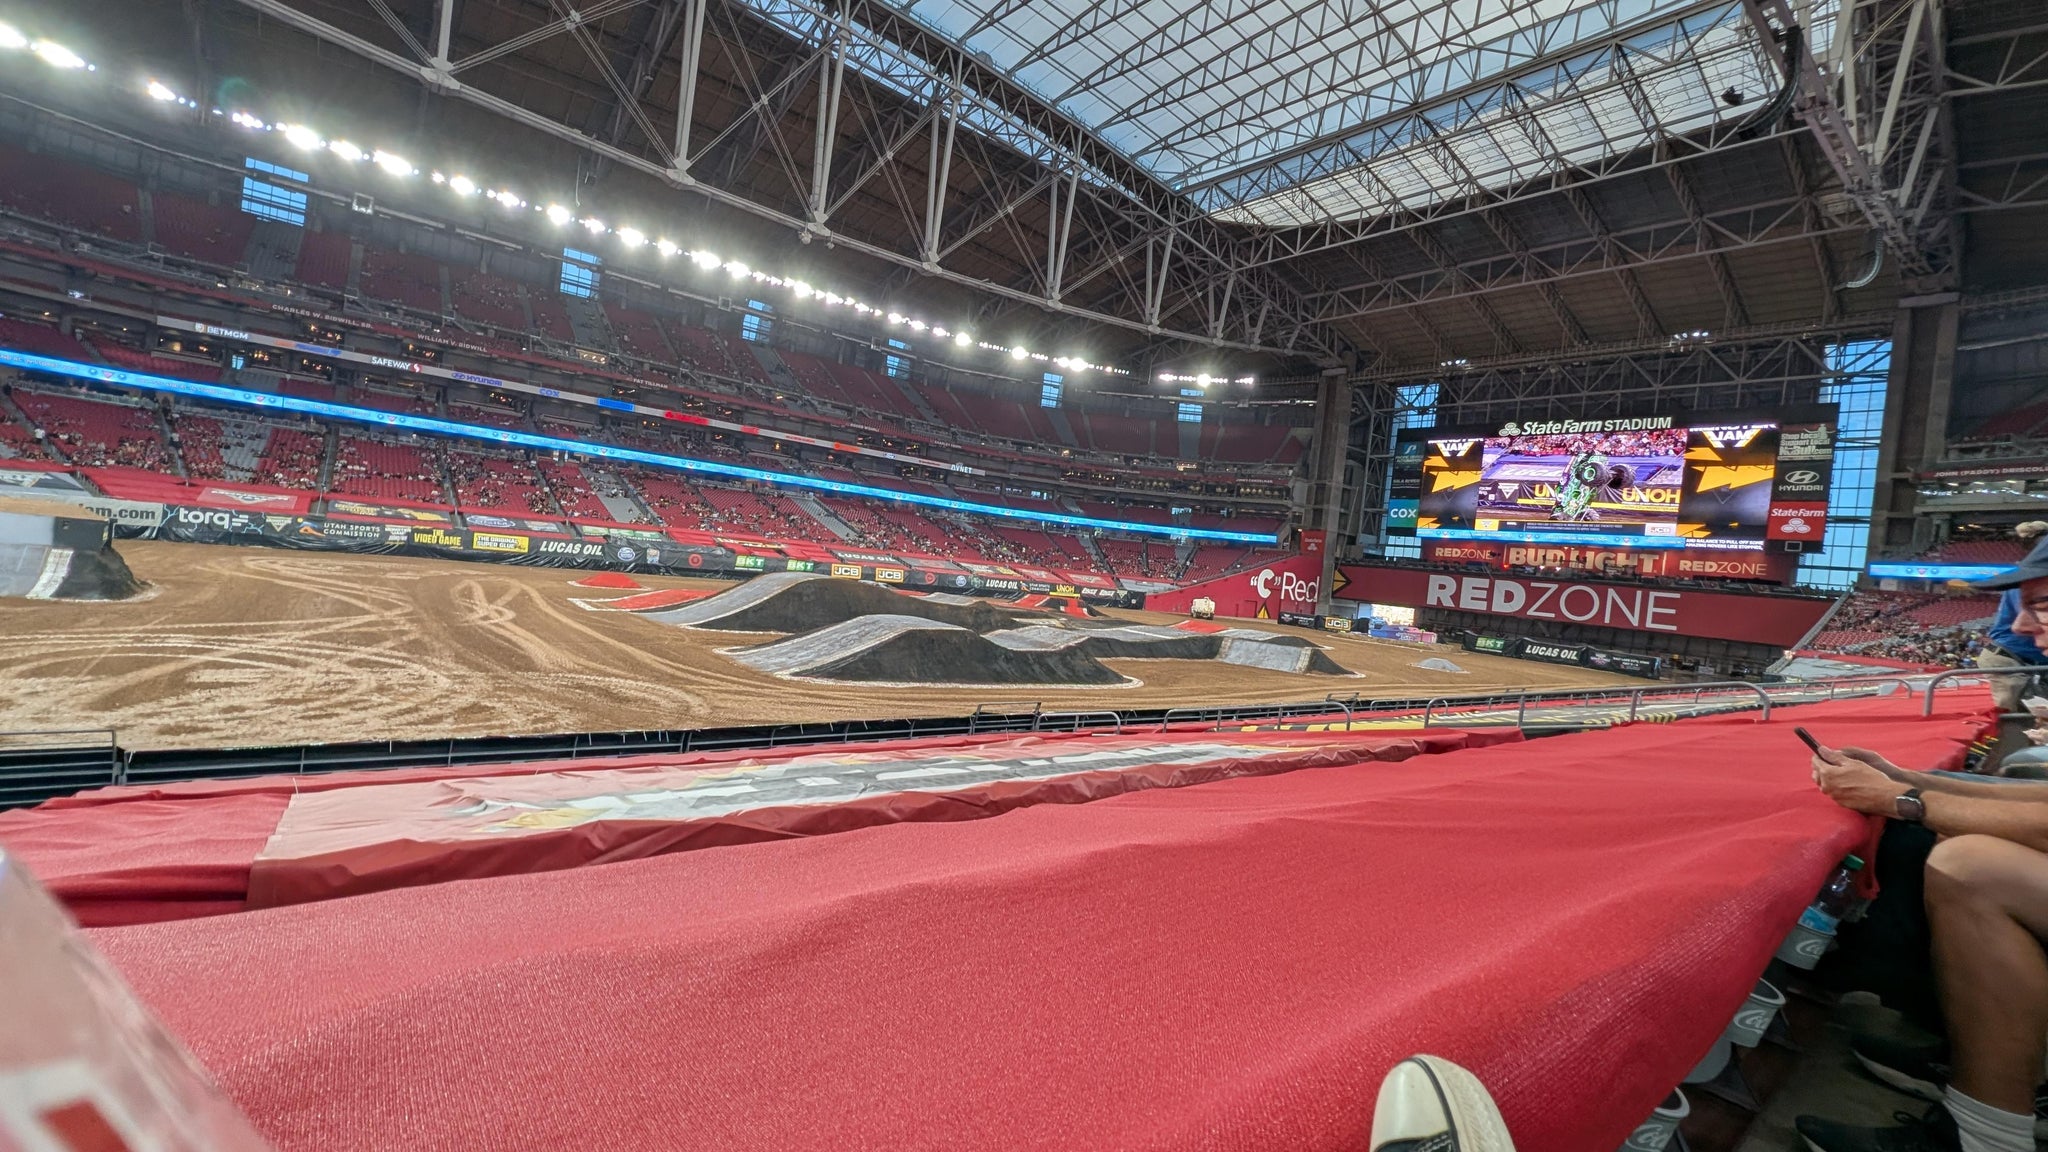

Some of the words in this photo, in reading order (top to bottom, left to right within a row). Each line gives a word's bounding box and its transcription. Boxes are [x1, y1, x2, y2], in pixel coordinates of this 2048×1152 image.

[271, 303, 311, 317] CHARLES
[207, 325, 249, 340] BETMGM
[417, 333, 449, 346] WILLIAM
[371, 356, 411, 371] SAFEWAY
[466, 374, 503, 387] HYUNDAI
[633, 377, 645, 385] PAT
[645, 379, 669, 389] TILLMAN
[539, 387, 560, 398] COX
[1603, 416, 1673, 432] STADIUM
[1780, 438, 1810, 447] Support
[1781, 433, 1800, 442] Shop
[951, 463, 973, 474] AVNET
[1778, 484, 1824, 492] HYUNDAI
[1621, 487, 1681, 504] UNOH
[1390, 507, 1417, 519] COX
[323, 522, 346, 532] UTAH
[349, 523, 381, 533] SPORTS
[323, 528, 380, 538] COMMISSION
[432, 529, 444, 537] THE
[414, 533, 438, 544] VIDEO
[438, 535, 462, 546] GAME
[490, 536, 518, 544] ORIGINAL
[540, 540, 582, 555] LUCAS
[583, 545, 603, 556] OIL
[736, 555, 763, 567] BKT
[837, 551, 875, 561] LUCAS
[1508, 547, 1566, 567] BUD
[1569, 549, 1660, 573] LIGHT
[787, 560, 815, 571] BKT
[834, 565, 860, 577] JCB
[1679, 559, 1768, 576] REDZONE
[877, 569, 902, 580] JCB
[985, 578, 1007, 589] LUCAS
[1008, 581, 1018, 590] OIL
[1056, 584, 1075, 594] UNOH
[1280, 571, 1320, 603] Red
[1426, 574, 1682, 631] REDZONE
[1327, 619, 1349, 629] JCB
[1476, 637, 1504, 648] BKT
[1525, 644, 1559, 658] LUCAS
[1560, 649, 1579, 661] OIL
